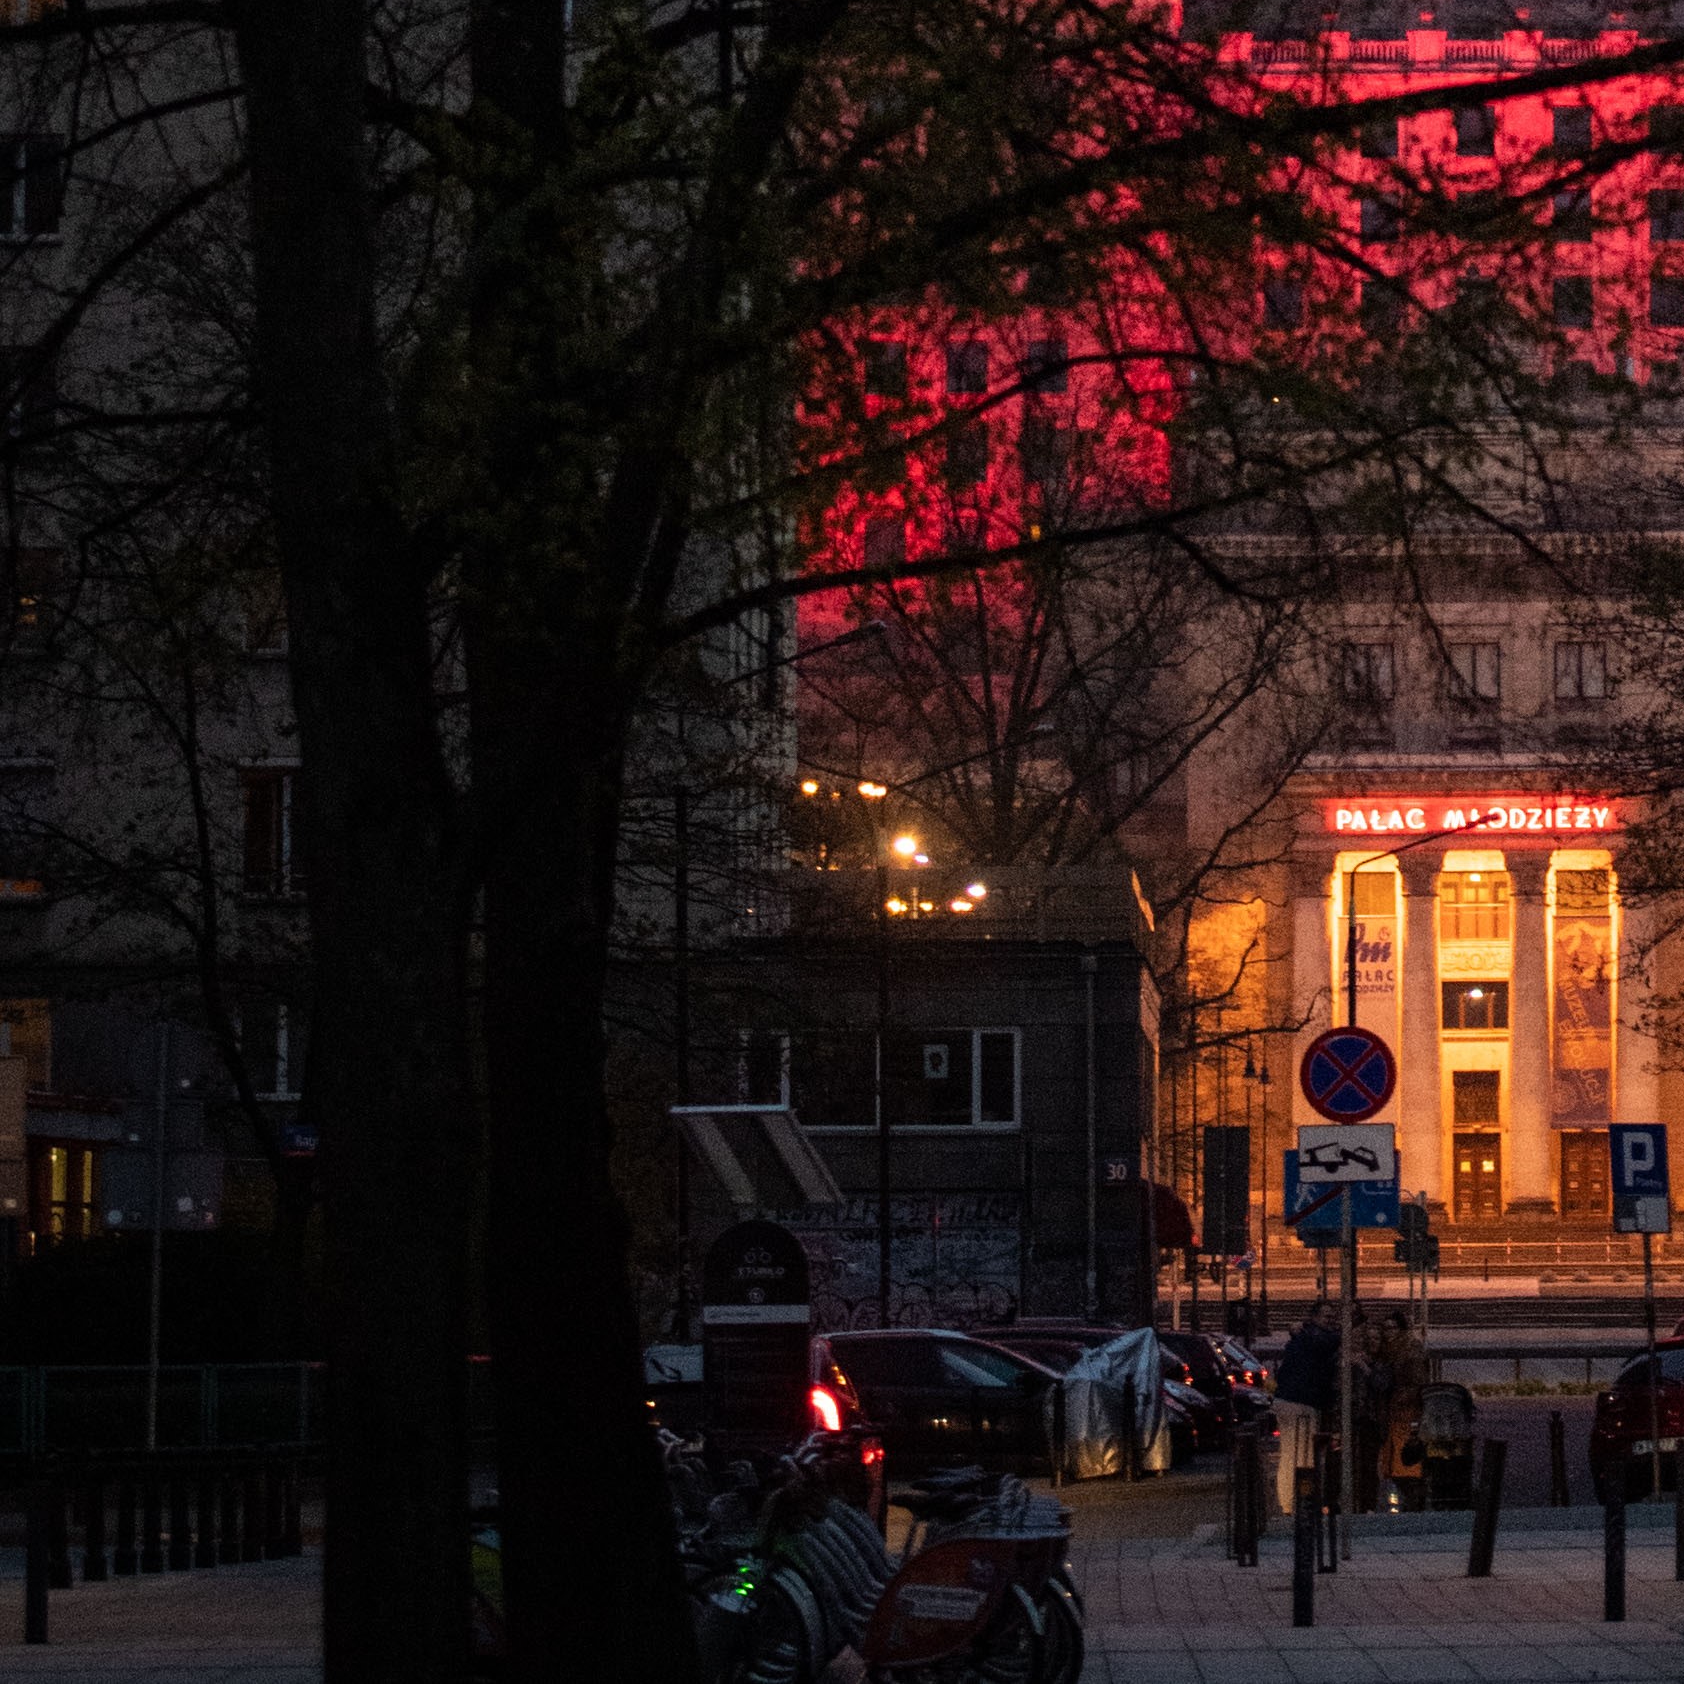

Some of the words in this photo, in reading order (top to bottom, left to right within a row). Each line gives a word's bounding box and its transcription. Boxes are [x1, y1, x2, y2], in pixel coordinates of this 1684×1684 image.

[1335, 808, 1426, 830] PAŁAC
[1443, 806, 1609, 829] MŁODZIEŻY
[1622, 1131, 1656, 1187] P
[1106, 1163, 1127, 1181] 30
